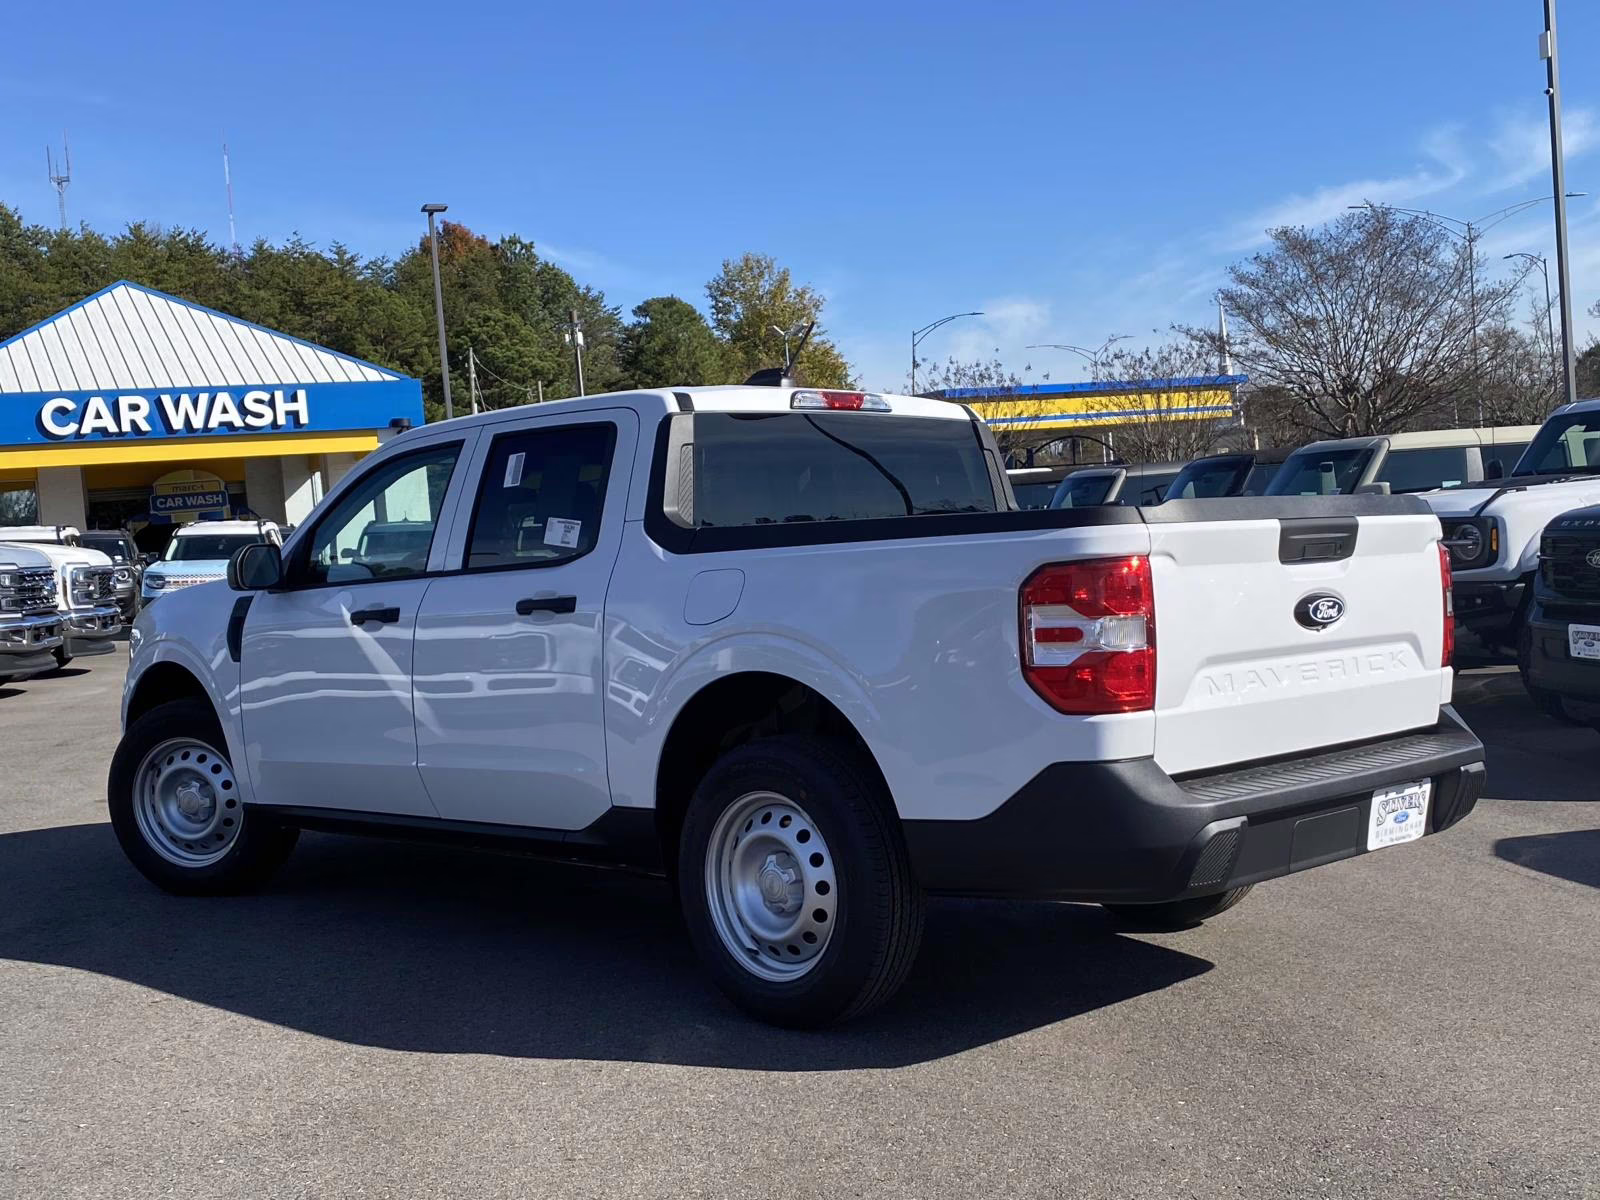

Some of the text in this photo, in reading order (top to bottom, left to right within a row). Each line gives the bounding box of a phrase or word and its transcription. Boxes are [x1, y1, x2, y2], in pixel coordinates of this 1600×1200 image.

[40, 389, 309, 437] CAR WASH
[156, 494, 223, 508] CAR WASH
[1315, 601, 1340, 619] Ford
[1203, 650, 1409, 697] MAVERICK
[1376, 790, 1427, 828] STIVERS
